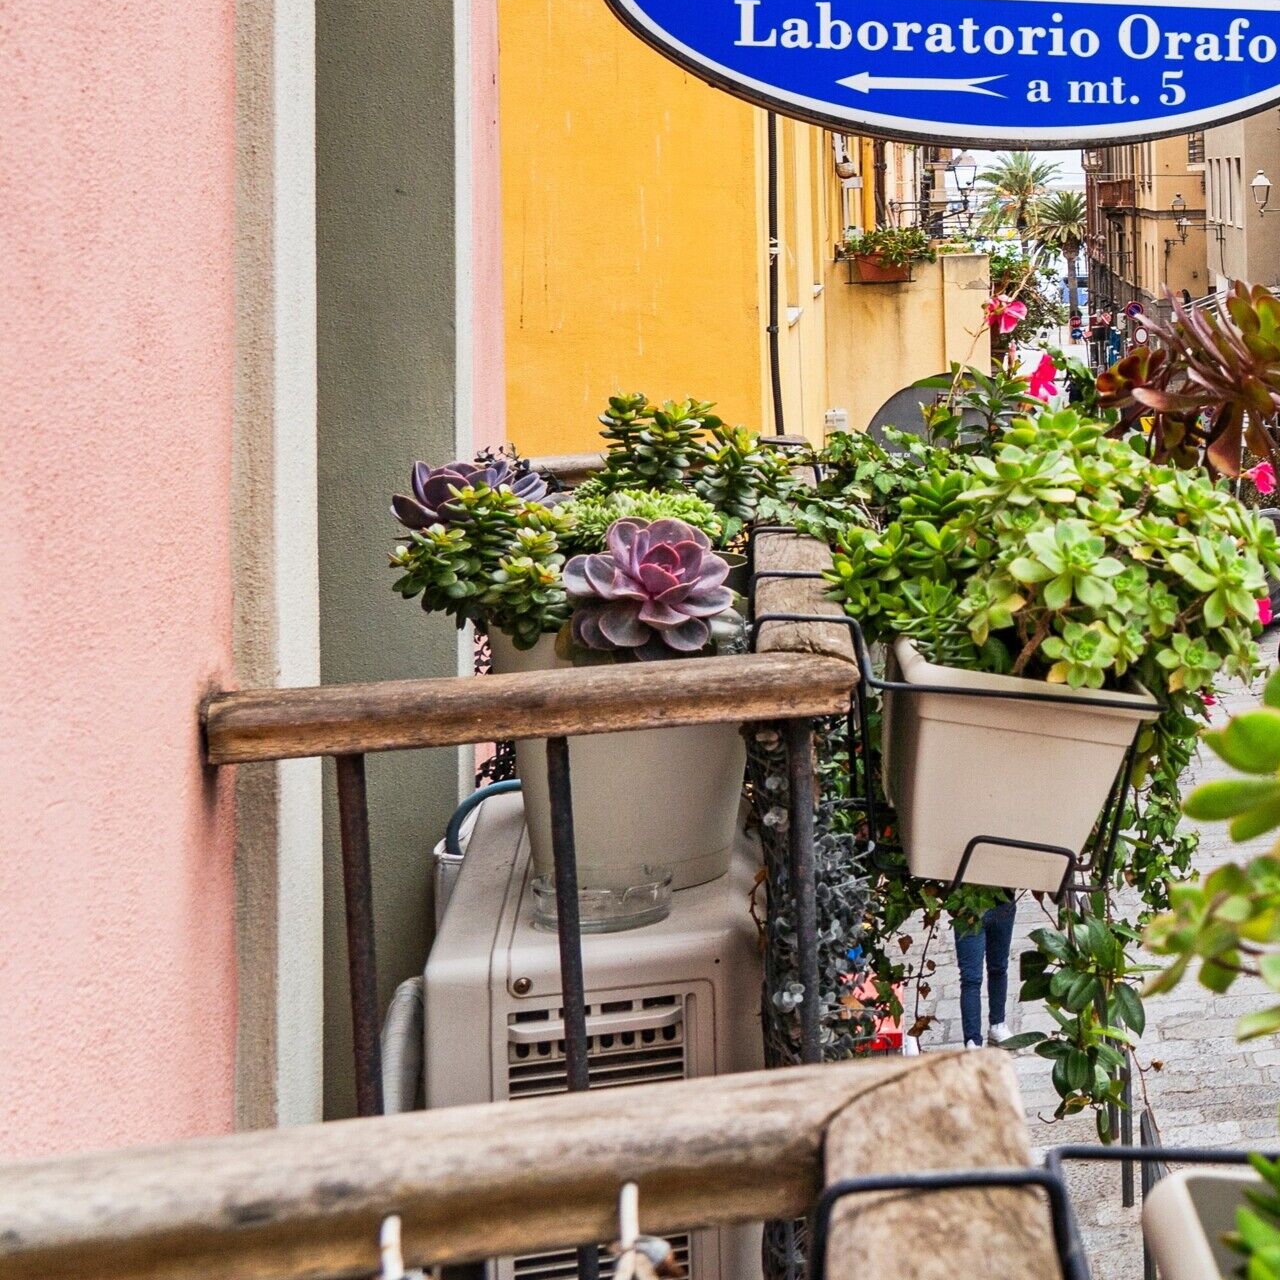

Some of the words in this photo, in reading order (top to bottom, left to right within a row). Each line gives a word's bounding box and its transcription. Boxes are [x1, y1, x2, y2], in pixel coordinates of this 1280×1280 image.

[734, 0, 1101, 58] Laboratorio
[1118, 14, 1278, 64] Orafo
[1026, 79, 1051, 103] a
[1068, 74, 1140, 106] mt.
[1159, 69, 1187, 106] 5
